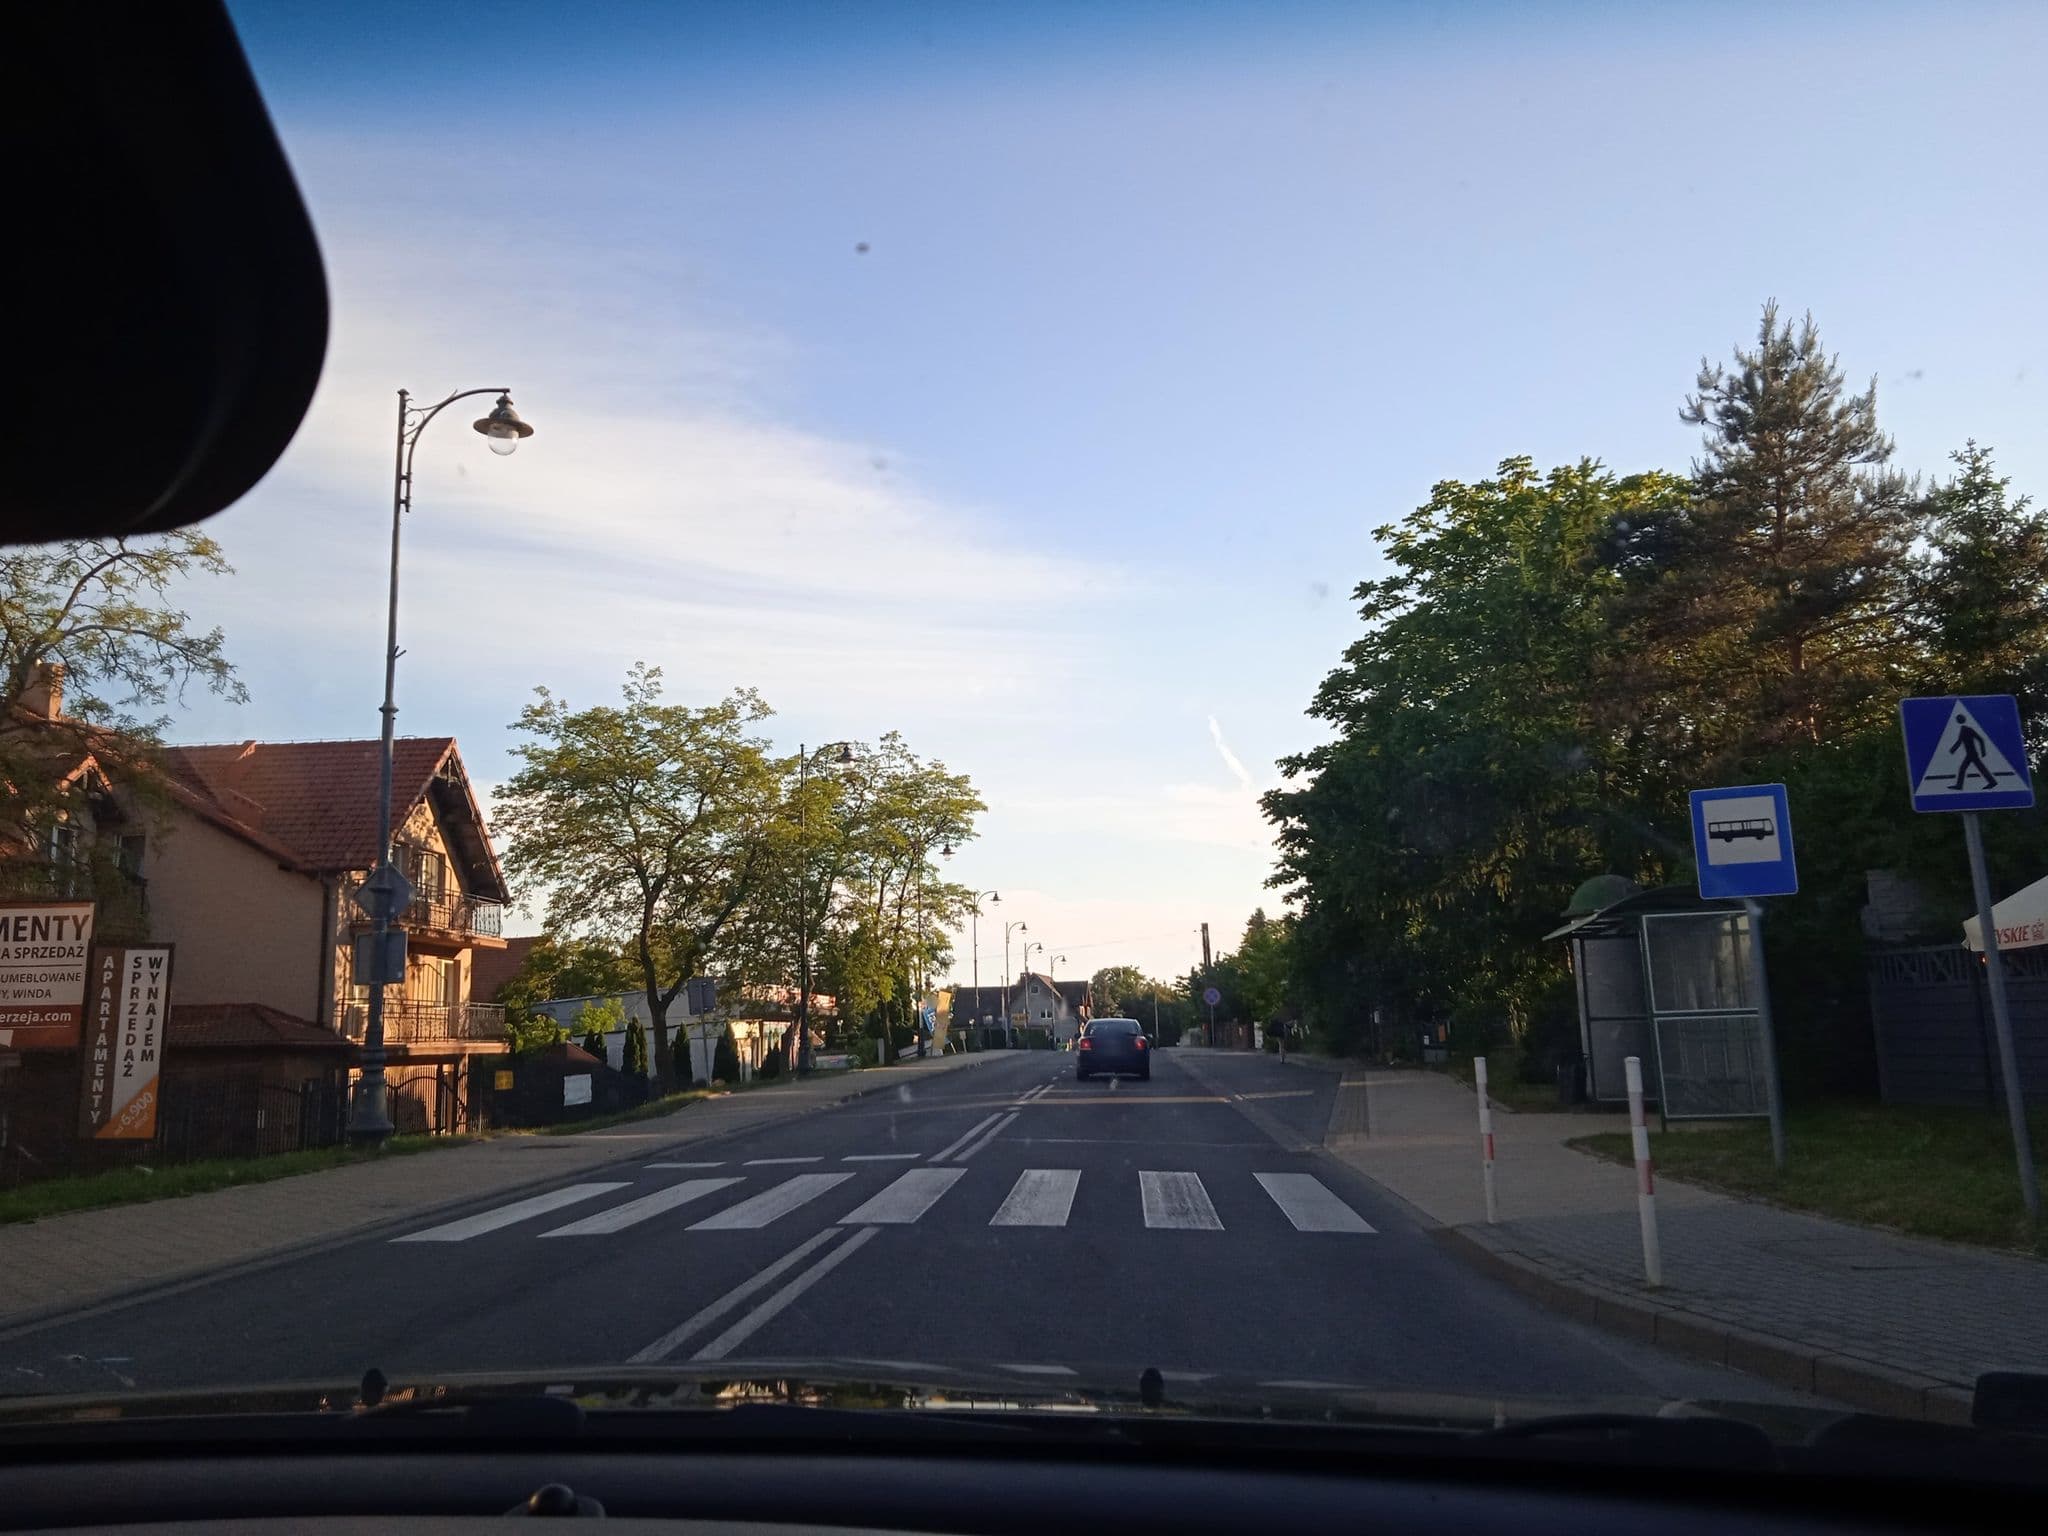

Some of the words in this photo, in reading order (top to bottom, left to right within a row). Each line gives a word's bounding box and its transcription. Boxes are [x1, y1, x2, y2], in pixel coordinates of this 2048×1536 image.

[1994, 925, 2030, 944] YSKIE
[14, 944, 85, 959] SPRZEDAŻ
[0, 972, 81, 983] UMEBLOWANE
[13, 988, 52, 999] WINDA
[122, 956, 142, 1077] SPRZEDAŻ
[140, 956, 163, 1062] WYNAJEM
[90, 956, 114, 1124] APARTAMENTY
